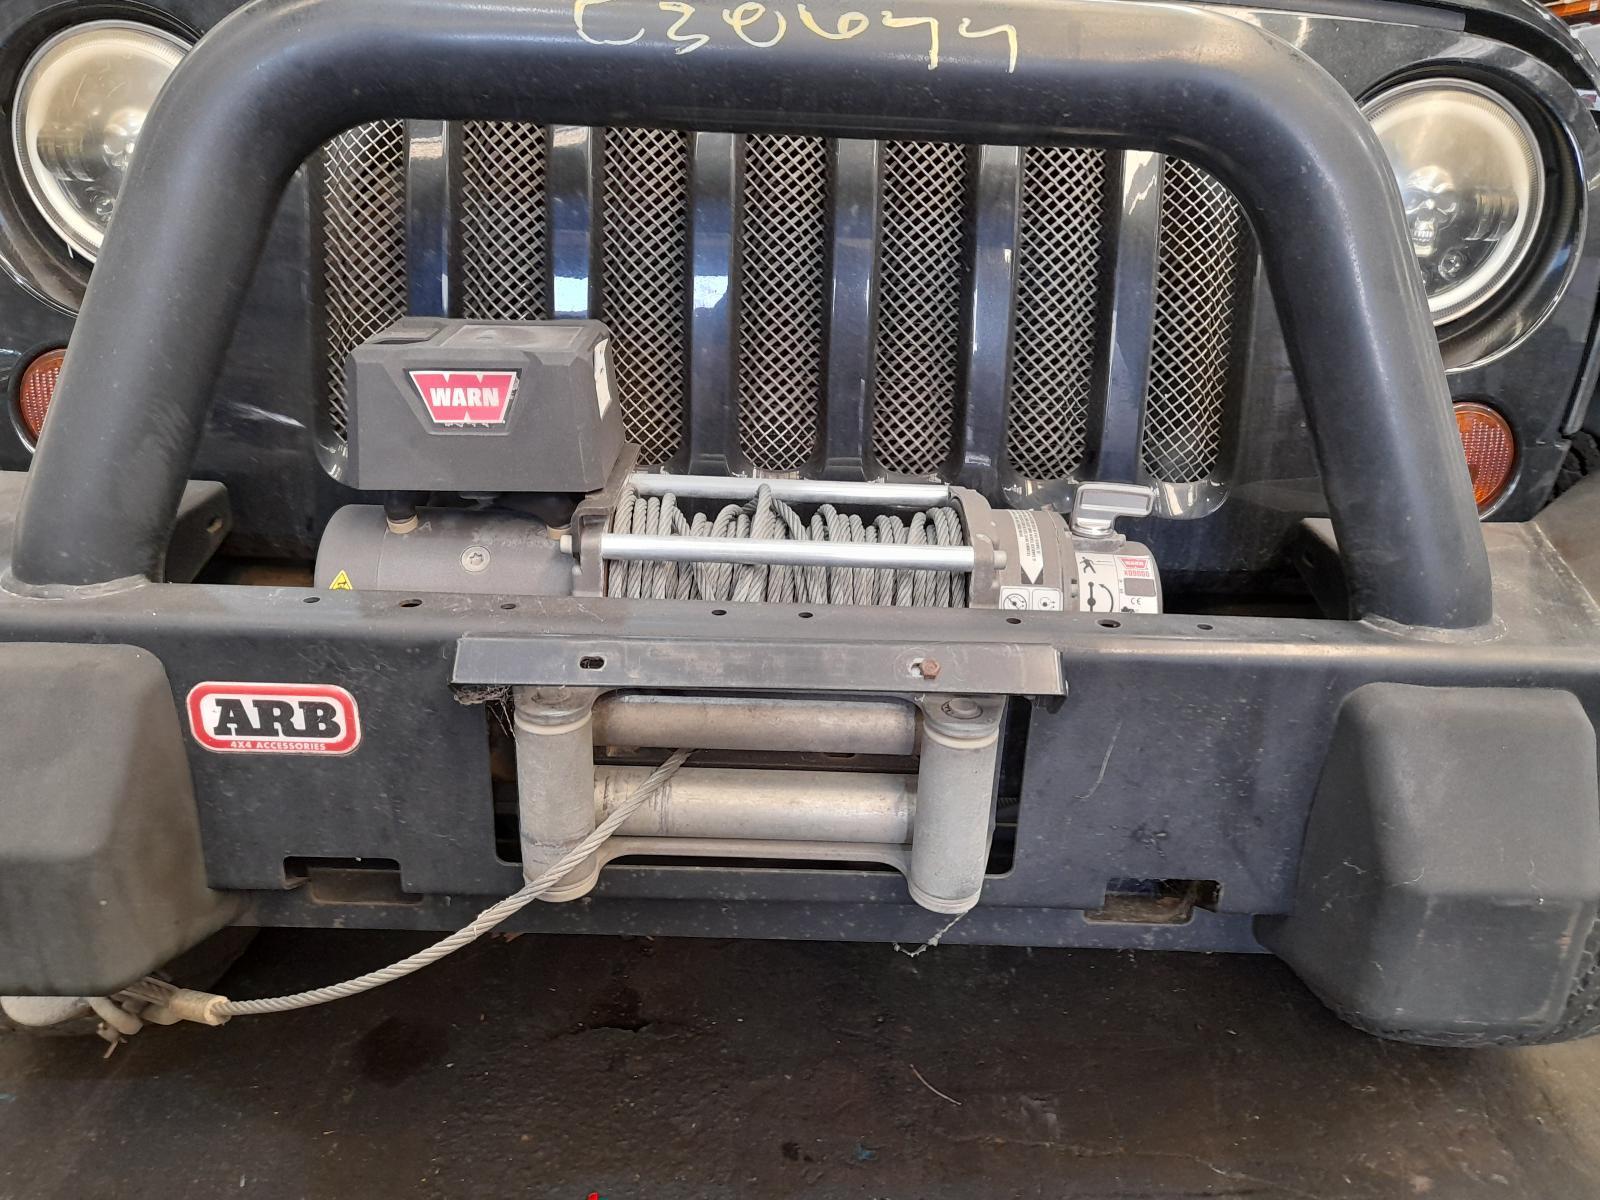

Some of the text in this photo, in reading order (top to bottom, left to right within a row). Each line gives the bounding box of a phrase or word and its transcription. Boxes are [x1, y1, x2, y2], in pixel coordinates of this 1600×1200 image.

[430, 387, 500, 407] WARN
[214, 698, 341, 738] ARB
[256, 741, 326, 751] ACCESSORIES
